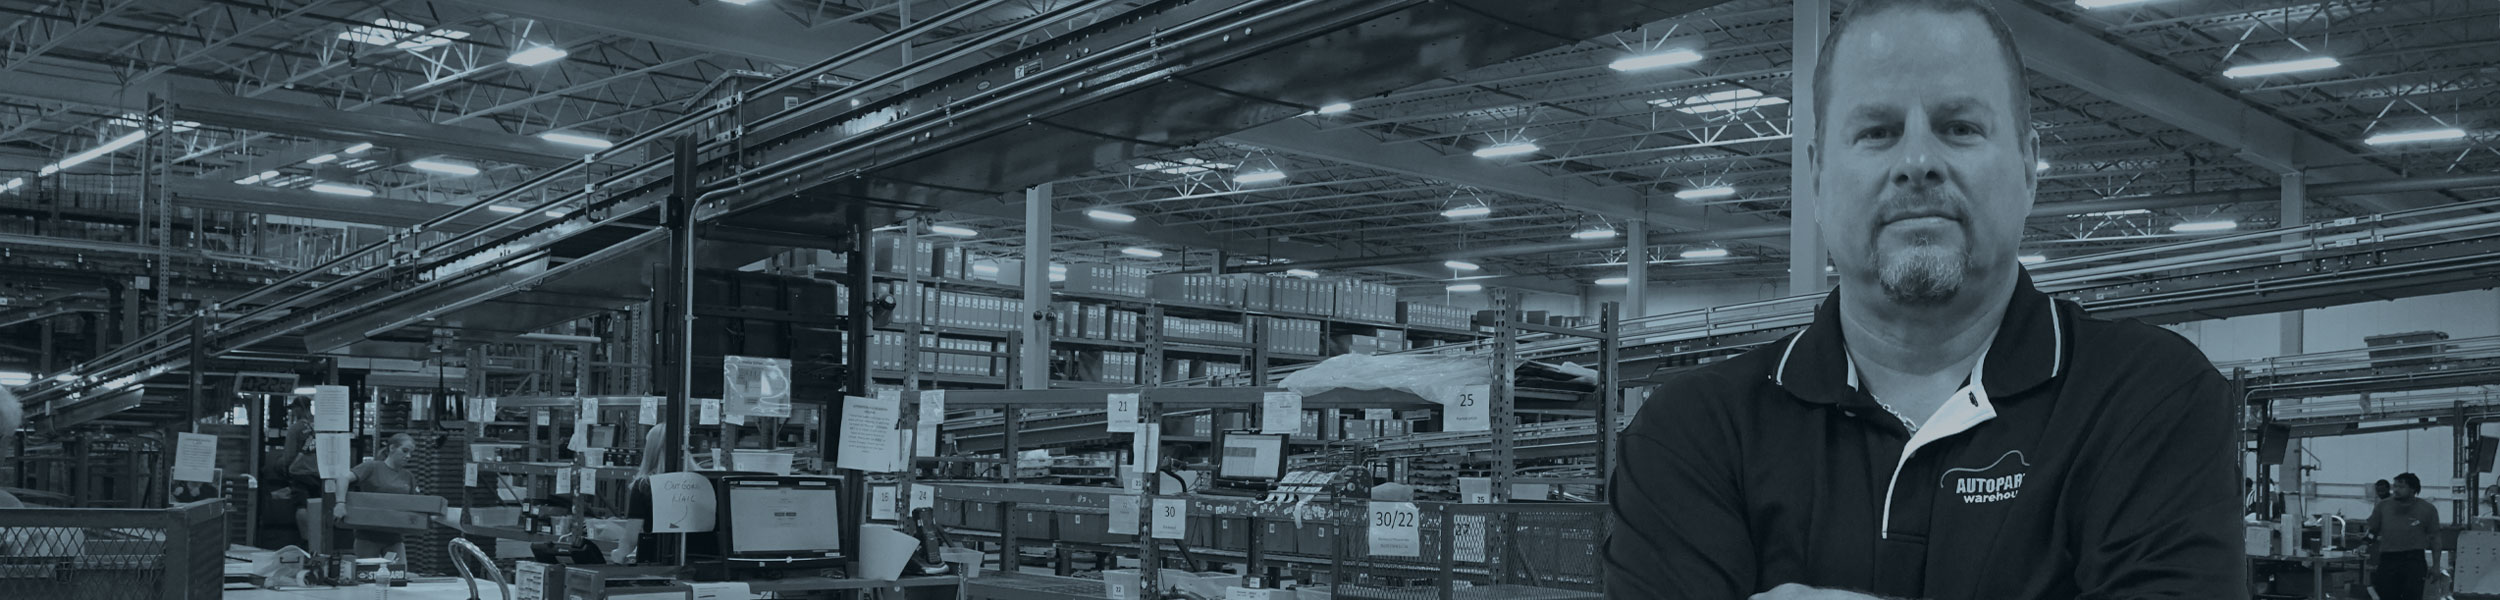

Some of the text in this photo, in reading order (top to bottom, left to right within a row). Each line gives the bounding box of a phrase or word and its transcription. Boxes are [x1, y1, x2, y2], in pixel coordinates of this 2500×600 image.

[1118, 401, 1127, 412] 21
[1460, 394, 1474, 407] 25
[1956, 472, 2025, 494] AUTOPAR
[919, 490, 927, 500] 24
[1164, 506, 1176, 517] 30
[1376, 510, 1414, 529] 30/22
